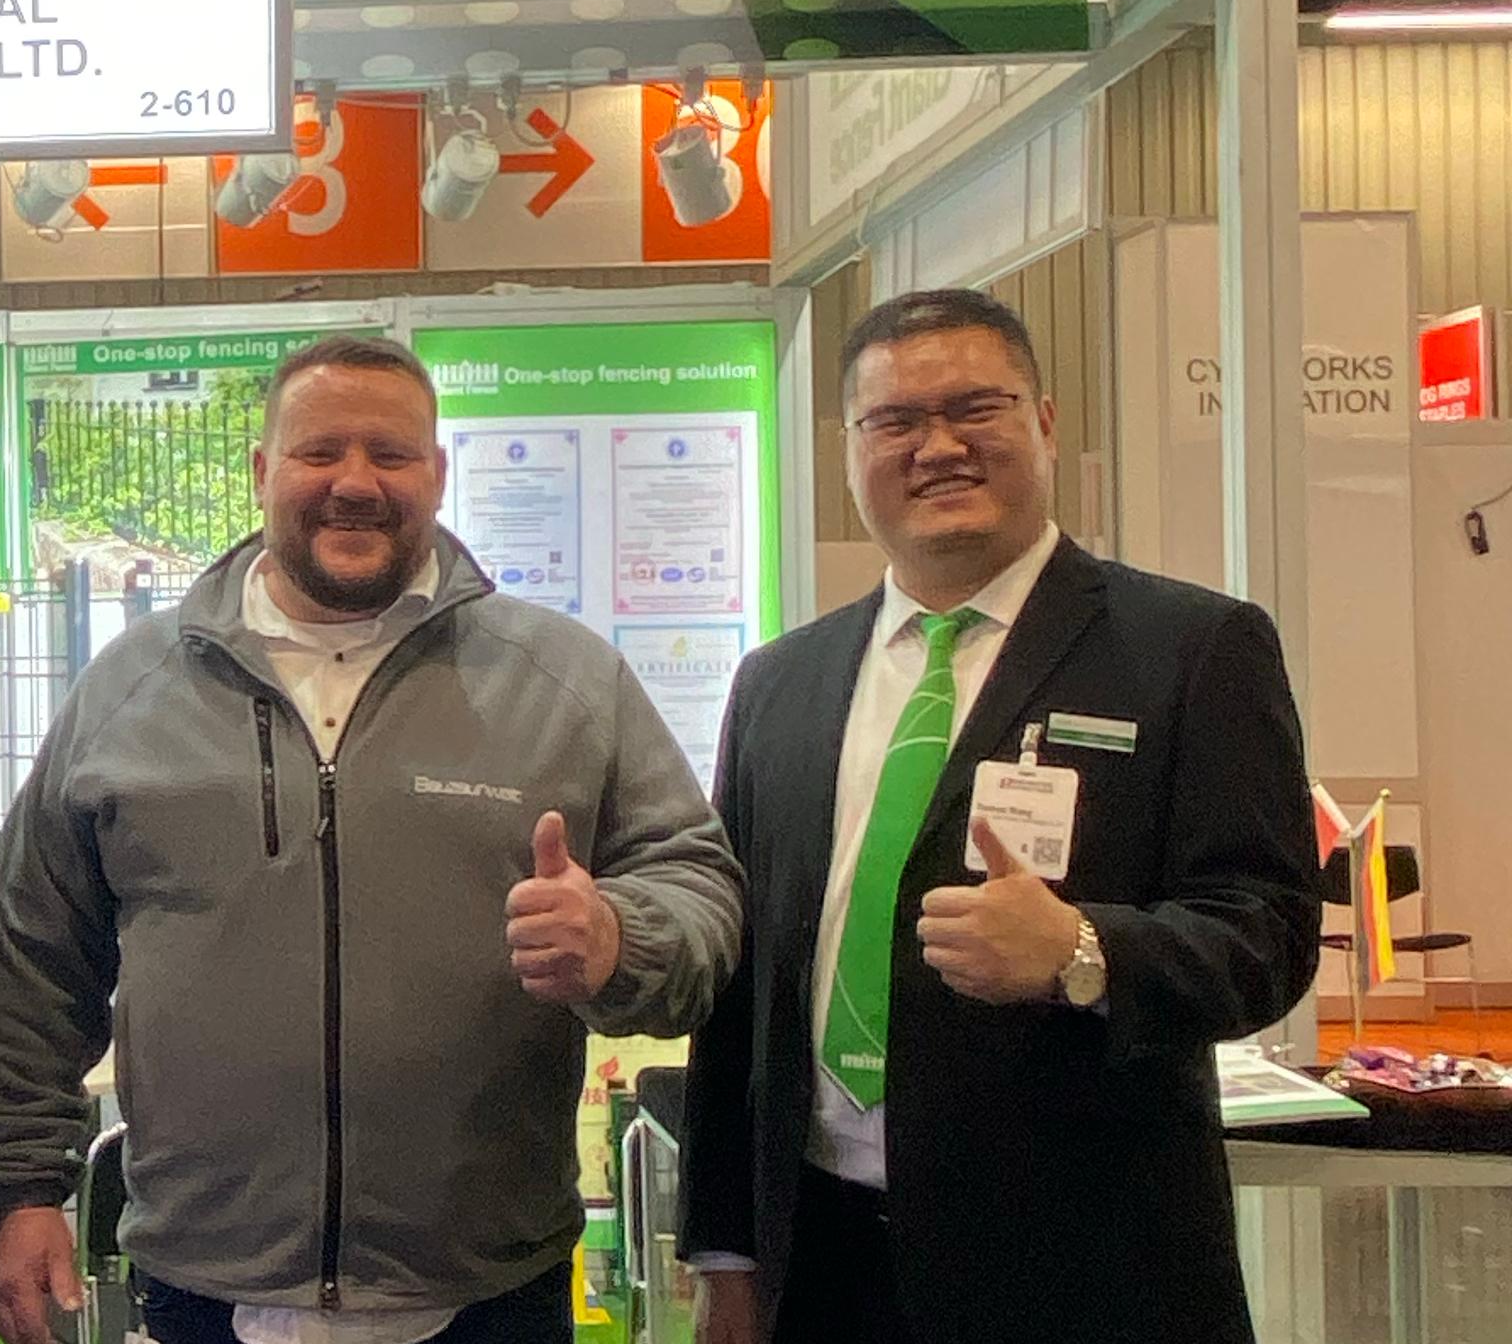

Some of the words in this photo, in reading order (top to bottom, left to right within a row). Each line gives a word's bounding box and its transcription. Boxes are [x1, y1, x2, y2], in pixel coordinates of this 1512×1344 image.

[140, 88, 236, 118] 2-610
[92, 343, 191, 364] One-stop
[198, 339, 279, 360] fencing
[504, 366, 594, 384] One-stop
[598, 364, 672, 385] fencing
[676, 361, 758, 380] solution
